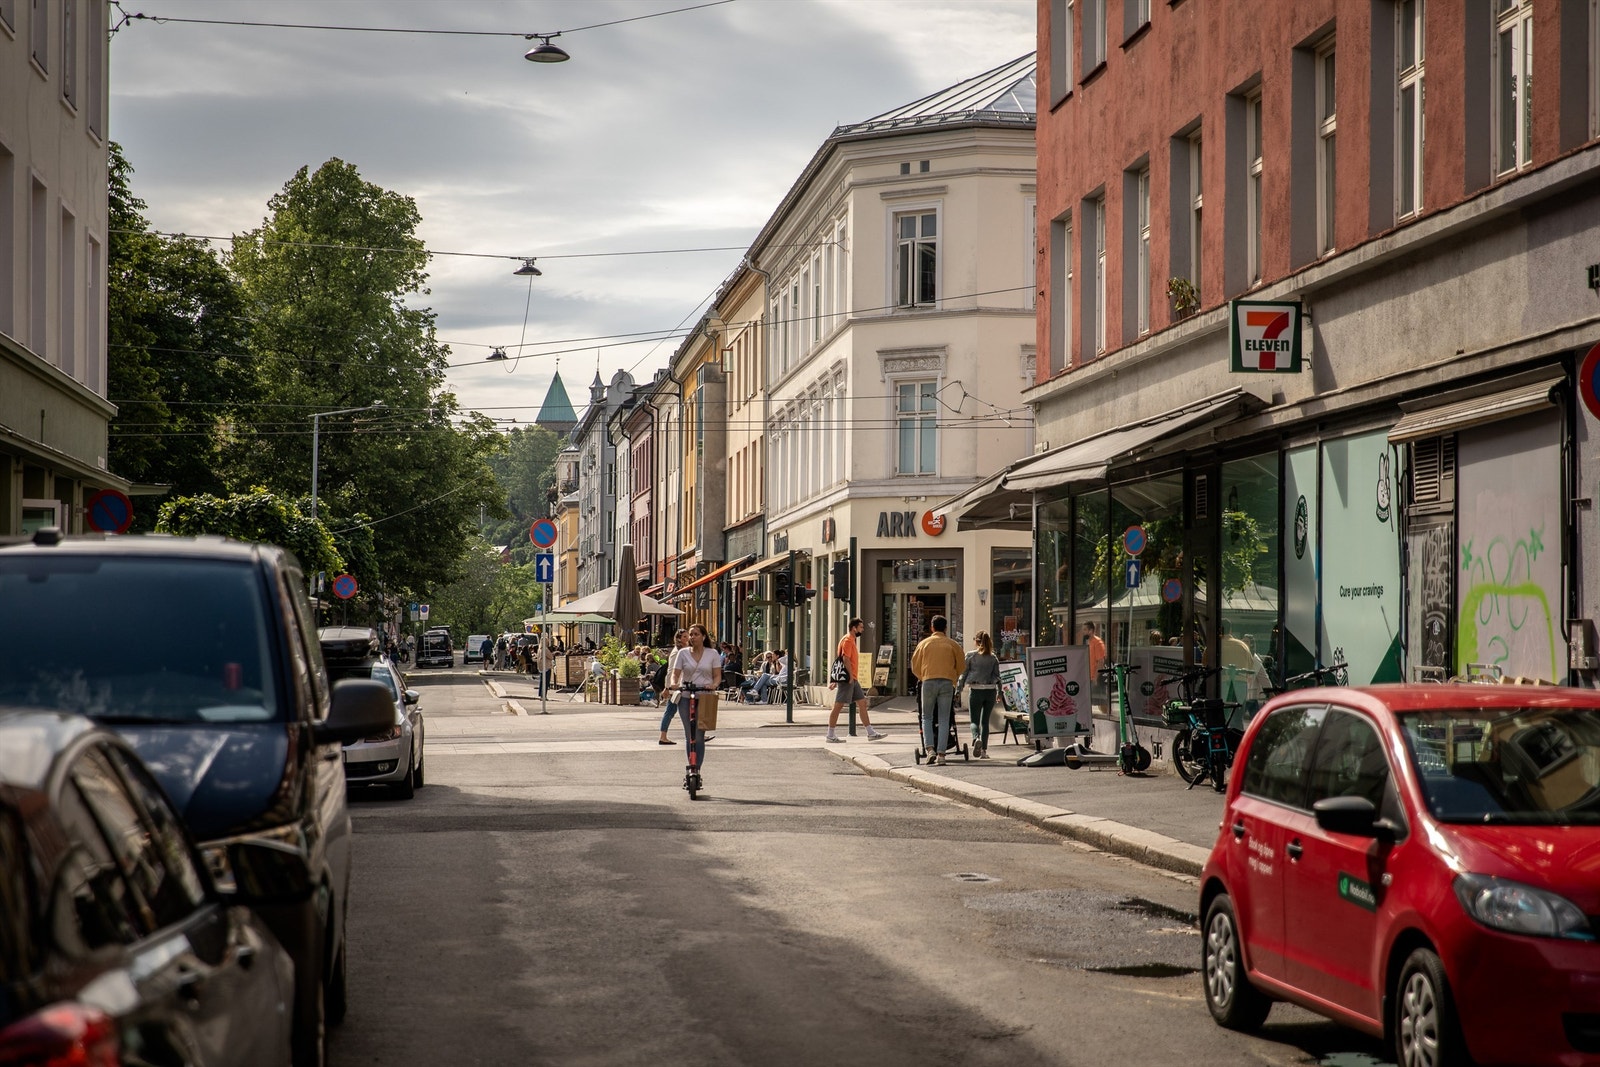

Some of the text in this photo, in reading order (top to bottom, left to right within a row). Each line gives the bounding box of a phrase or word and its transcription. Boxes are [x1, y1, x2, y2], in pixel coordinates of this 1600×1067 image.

[1247, 312, 1289, 370] 7
[876, 512, 916, 537] ARK
[1340, 582, 1384, 600] Cure your cravings
[1036, 666, 1065, 675] EVERYTHING
